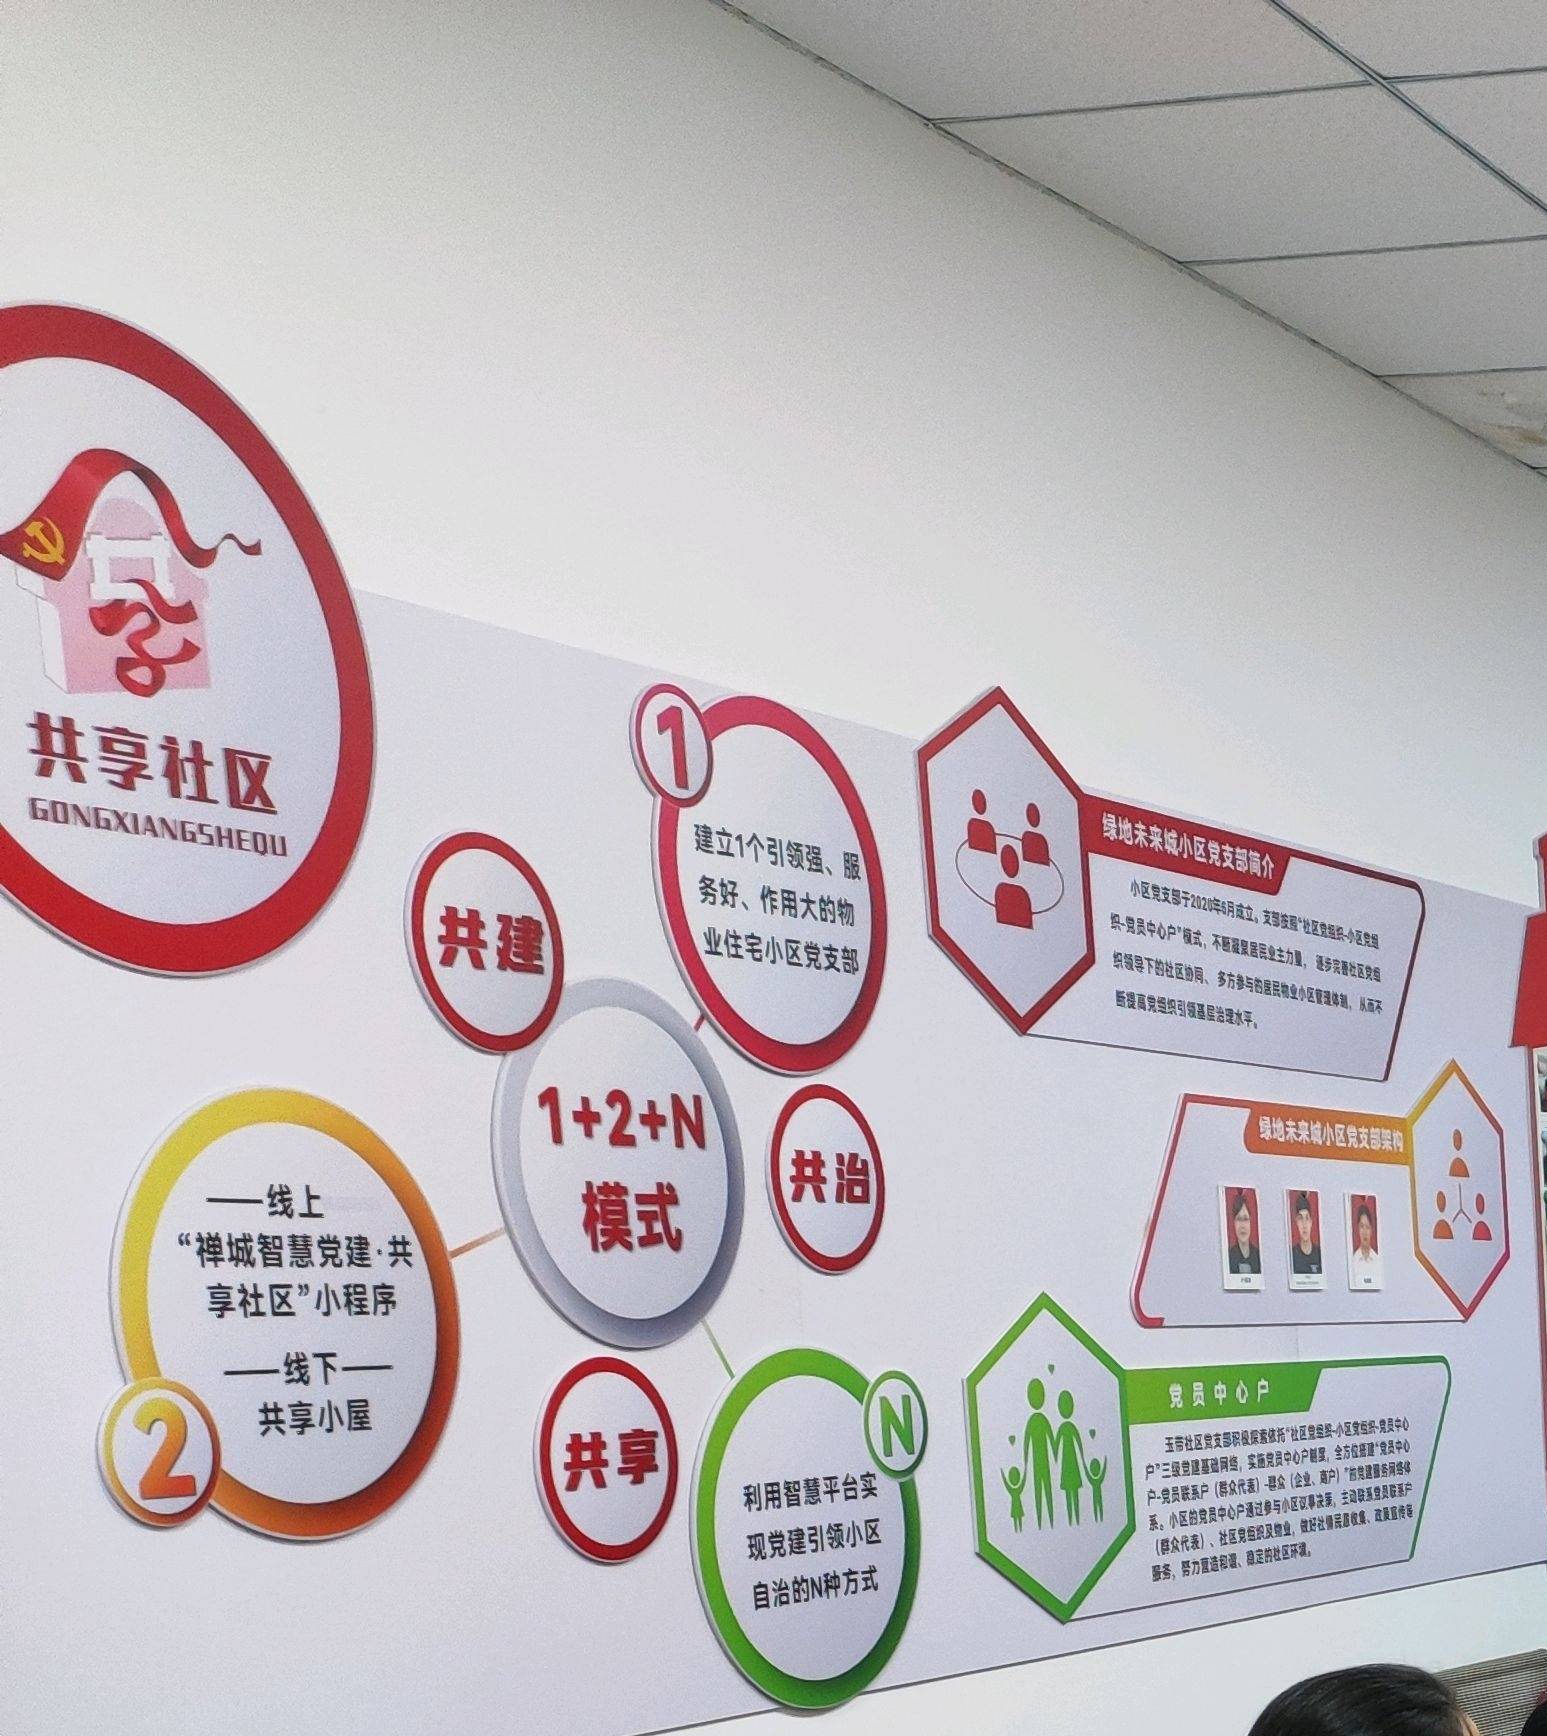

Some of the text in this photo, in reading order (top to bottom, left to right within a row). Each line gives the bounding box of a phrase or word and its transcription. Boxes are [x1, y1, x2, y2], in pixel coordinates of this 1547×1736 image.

[26, 710, 278, 815] 共享社区
[656, 705, 689, 791] 1
[28, 797, 288, 858] GONGXIANGSHEQU
[694, 823, 862, 881] 建立1个引领强、服
[1101, 812, 1275, 880] 绿地未来城小区党支部简介
[698, 876, 856, 928] 务好、作用大的物
[438, 905, 546, 975] 共建
[703, 926, 860, 975] 业住宅小区党支部
[538, 1085, 707, 1150] 1+2+N
[1258, 1116, 1404, 1152] 绿地未来城小区党支部架构
[789, 1149, 872, 1204] 共治
[581, 1180, 683, 1254] 模式
[206, 1282, 398, 1318] 享社区”小程序
[258, 1399, 373, 1437] 共享小屋
[1168, 1378, 1270, 1409] 党员中心户
[133, 1397, 197, 1499] 2
[879, 1394, 915, 1457] N
[563, 1428, 659, 1491] 共享
[743, 1471, 878, 1512] 利用智慧平台实
[746, 1518, 882, 1562] 现党建引领小区
[752, 1565, 879, 1611] 自治的N种方式
